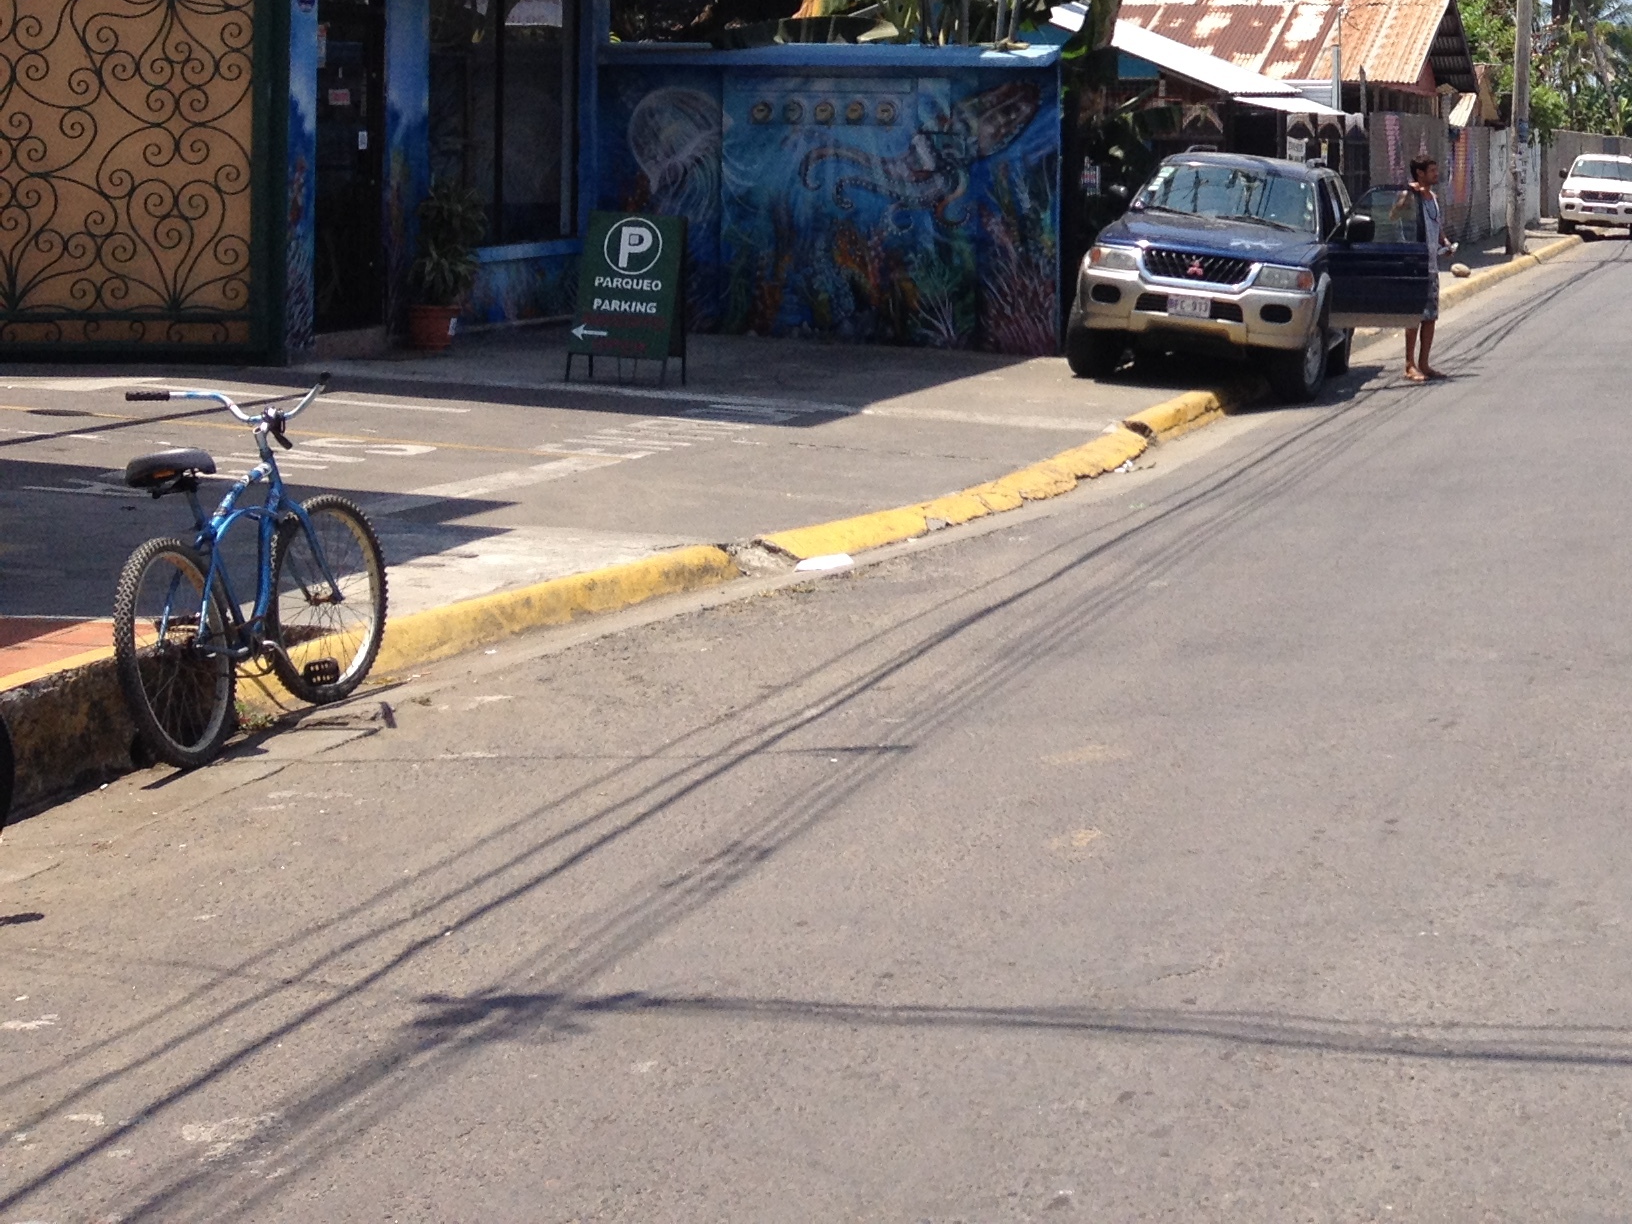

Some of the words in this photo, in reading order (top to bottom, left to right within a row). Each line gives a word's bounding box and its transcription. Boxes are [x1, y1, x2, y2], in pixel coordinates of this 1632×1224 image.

[618, 226, 653, 268] P
[594, 276, 662, 291] PARQUEO
[593, 298, 657, 314] PARKING
